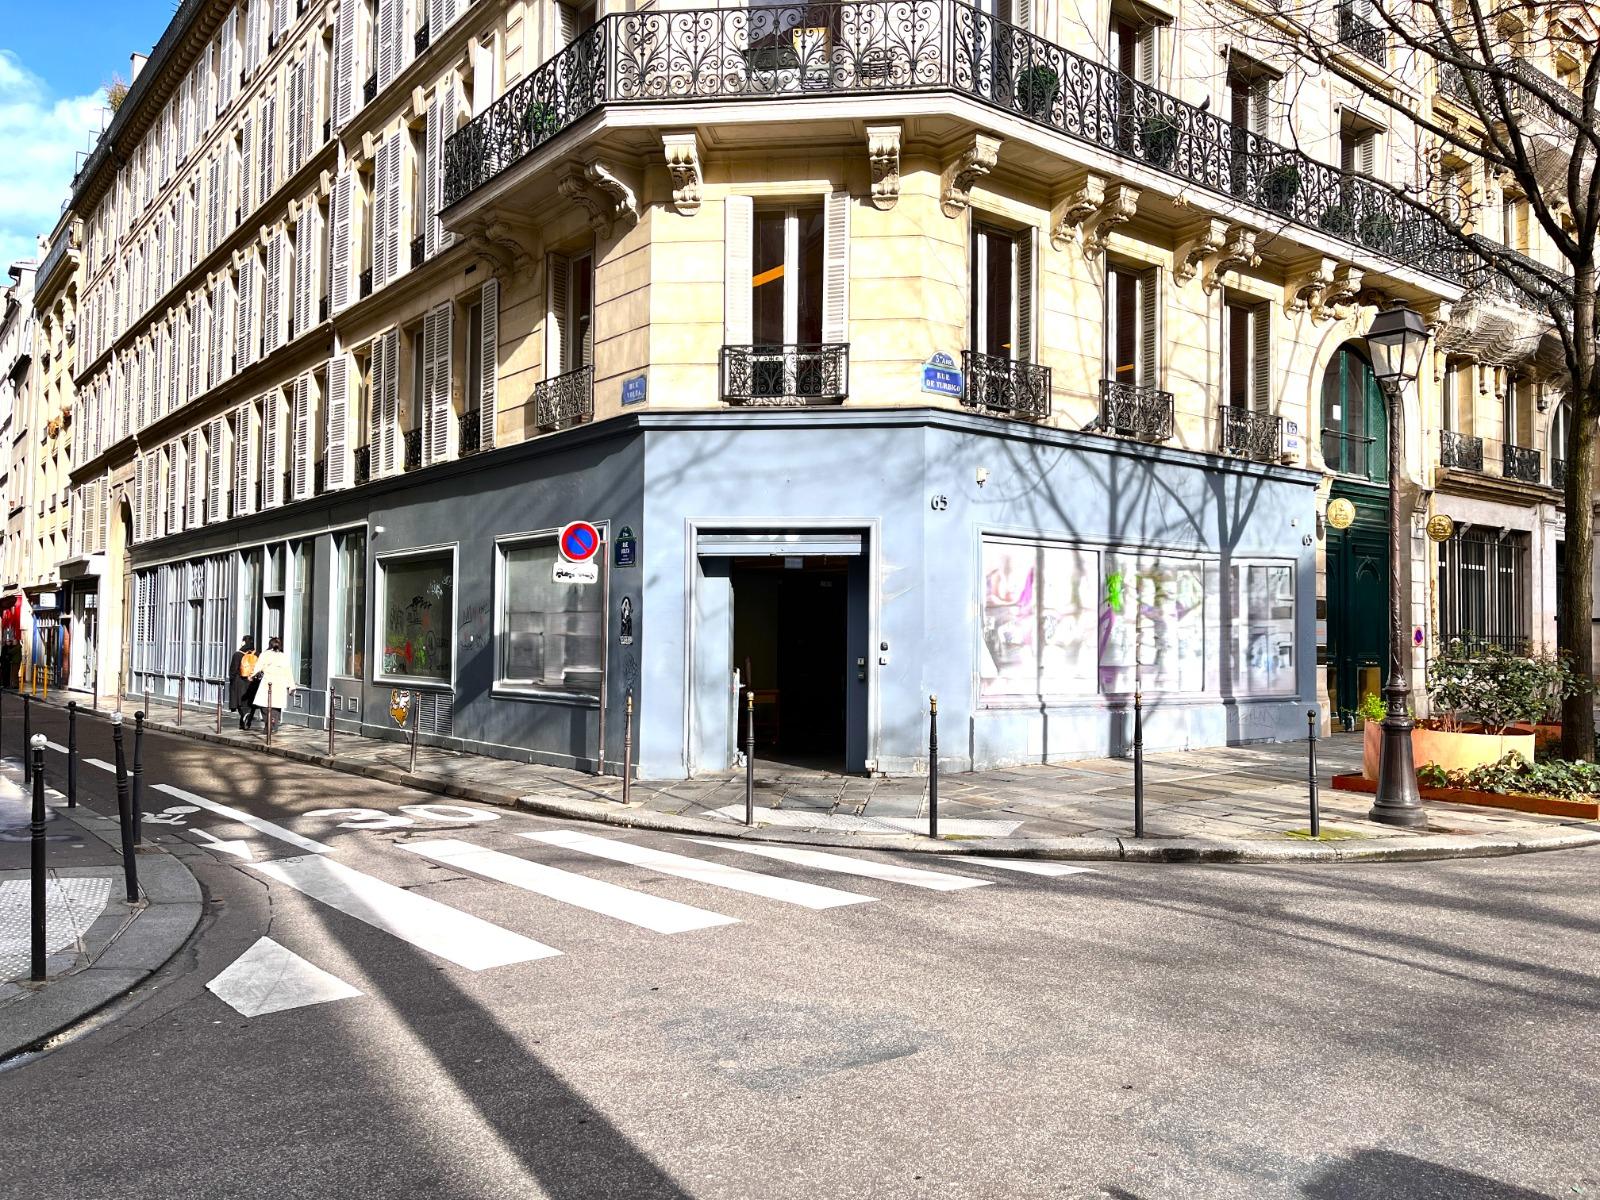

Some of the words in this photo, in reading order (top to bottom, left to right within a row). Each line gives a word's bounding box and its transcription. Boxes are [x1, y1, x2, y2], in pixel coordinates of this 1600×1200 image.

[937, 372, 950, 380] RUE
[931, 494, 948, 511] 65
[302, 804, 502, 830] 30
